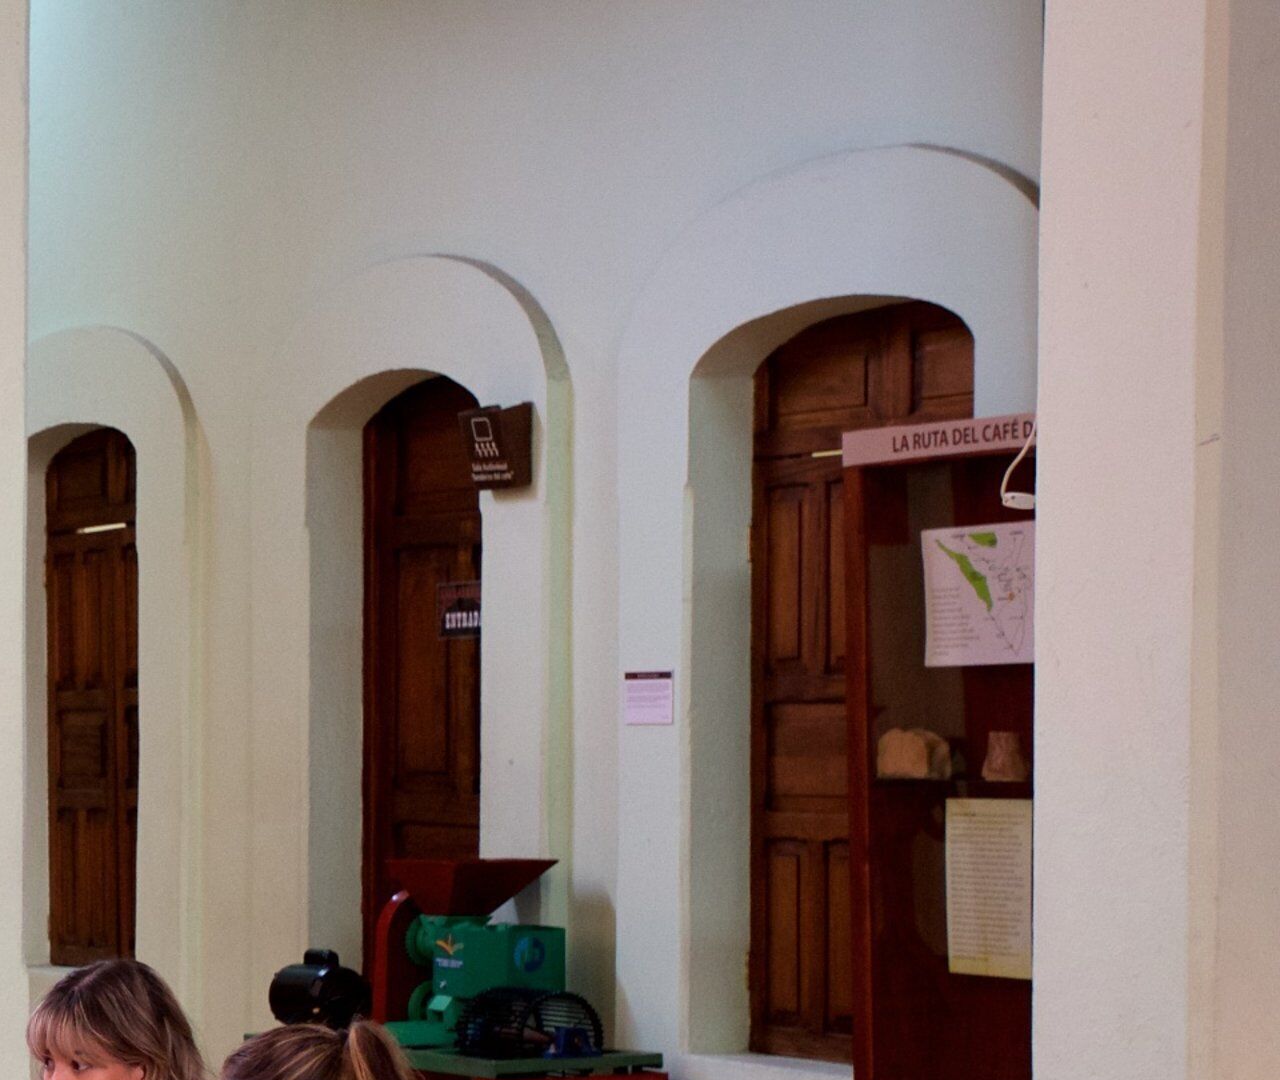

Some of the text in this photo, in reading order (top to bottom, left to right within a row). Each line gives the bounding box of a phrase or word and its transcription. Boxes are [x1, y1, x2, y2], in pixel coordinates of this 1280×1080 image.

[893, 419, 1037, 453] LA RUTA DEL CAFÉ D
[445, 611, 481, 629] ENTRAD
